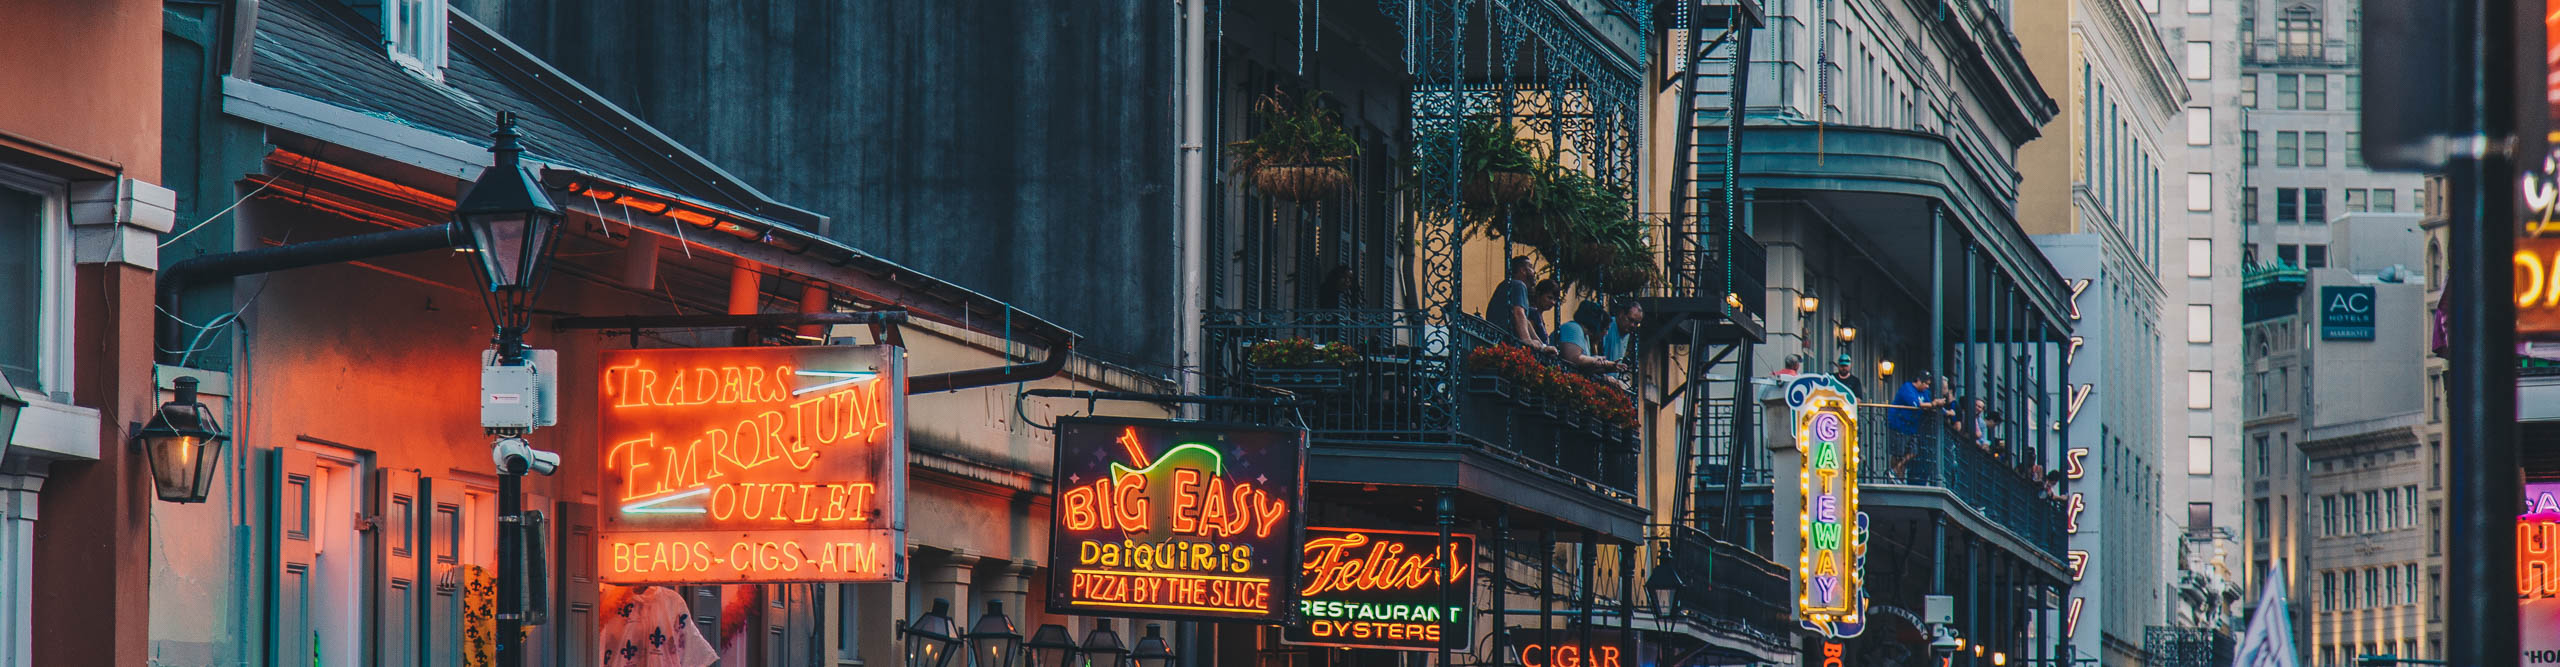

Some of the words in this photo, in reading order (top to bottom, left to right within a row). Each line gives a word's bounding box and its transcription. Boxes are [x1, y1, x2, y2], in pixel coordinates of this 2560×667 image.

[2329, 314, 2369, 322] HOTELS
[2330, 293, 2369, 313] AC
[2329, 329, 2368, 338] MARRIOTT
[606, 358, 792, 408] TRADERS
[608, 378, 887, 502] EMPORIUM
[711, 482, 875, 523] OUTLET
[1063, 471, 1149, 532] BIG
[1172, 467, 1285, 538] EASY
[1812, 412, 1841, 604] GATEWAY
[1071, 573, 1128, 602] PIZZA
[1133, 577, 1161, 603] BY
[1166, 578, 1206, 605] THE
[1210, 579, 1269, 609] SLICE
[1312, 621, 1440, 641] OYSTERS
